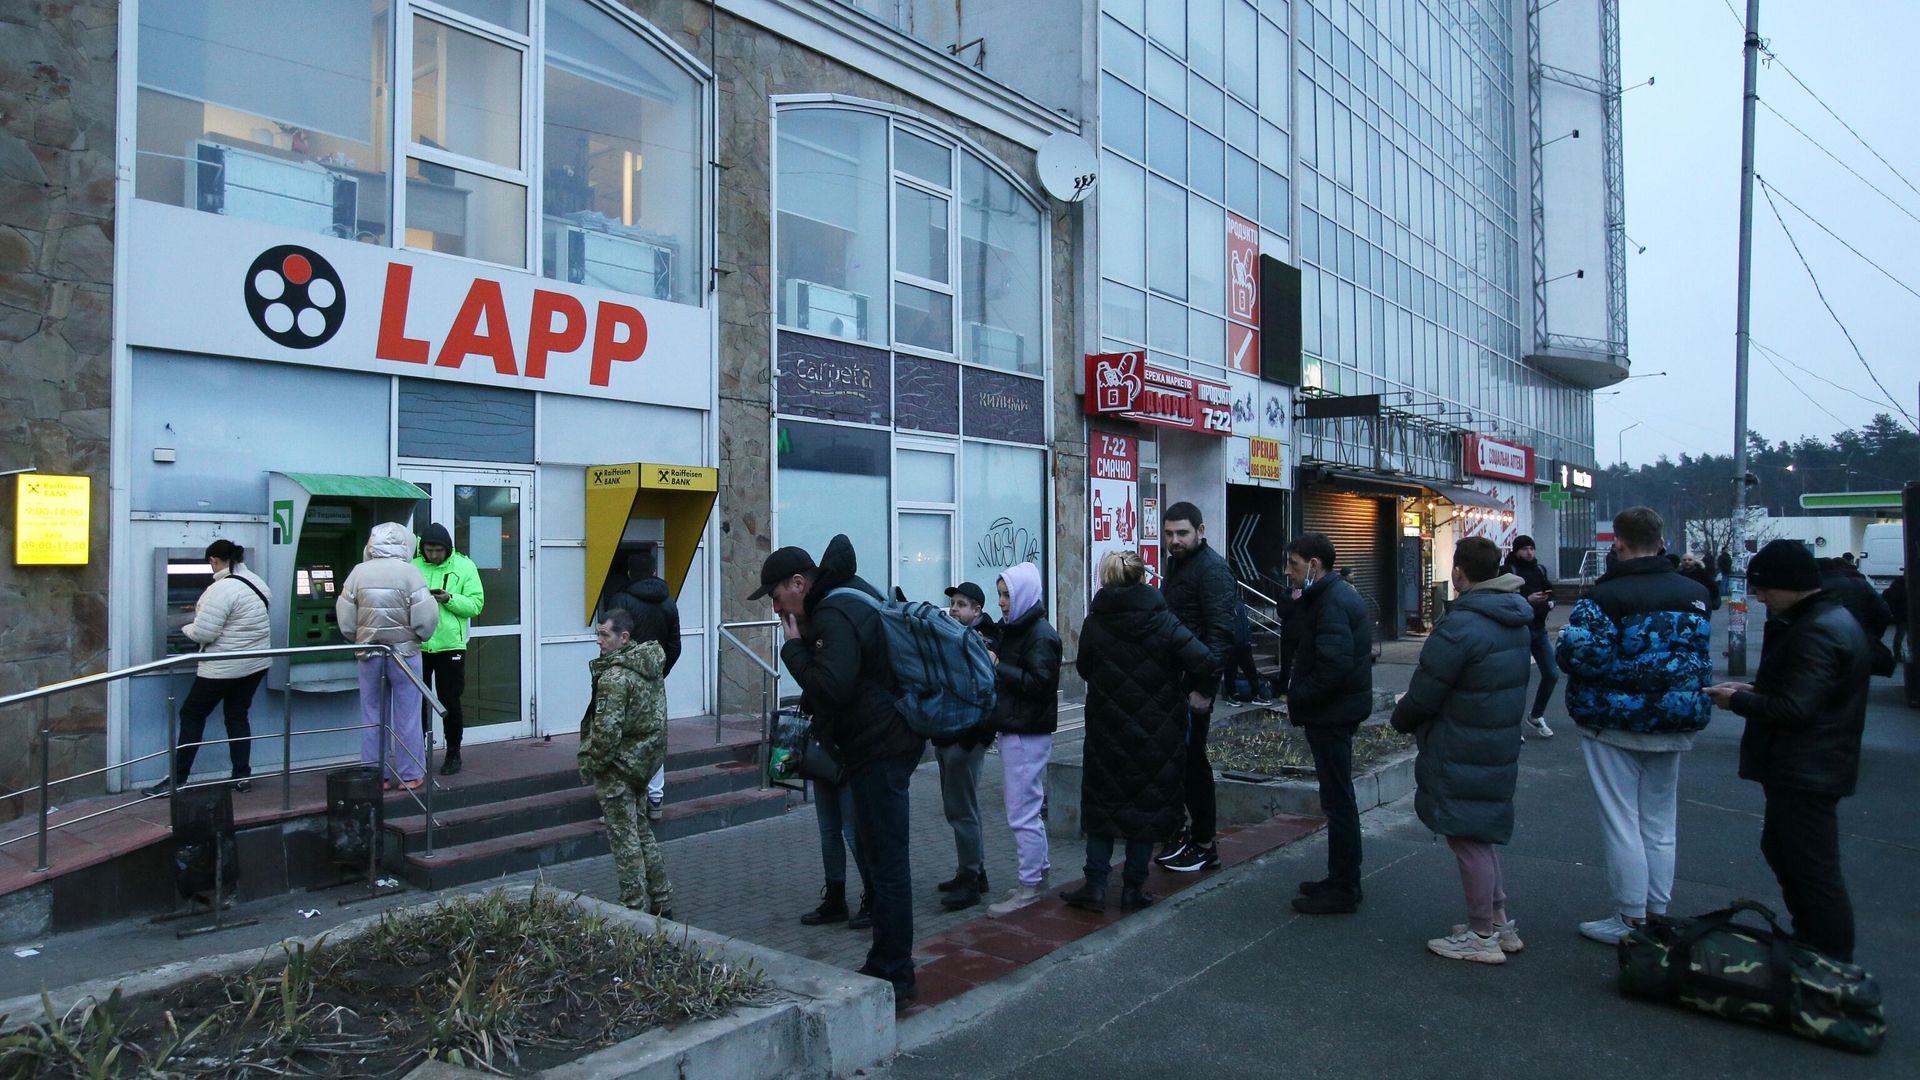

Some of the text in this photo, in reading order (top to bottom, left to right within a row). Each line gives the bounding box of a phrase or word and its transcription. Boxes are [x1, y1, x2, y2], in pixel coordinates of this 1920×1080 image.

[376, 262, 648, 387] LAPP
[1144, 370, 1165, 383] ЕРЕЖА
[1202, 408, 1231, 432] 7-22
[1101, 435, 1126, 457] 7-22
[1251, 439, 1279, 462] ОРЕНДА
[604, 468, 631, 476] Raiffeisen
[671, 469, 703, 478] Raiffeisen
[1096, 457, 1131, 479] СМАЧНО
[604, 477, 621, 485] BANK
[671, 478, 690, 486] BANK
